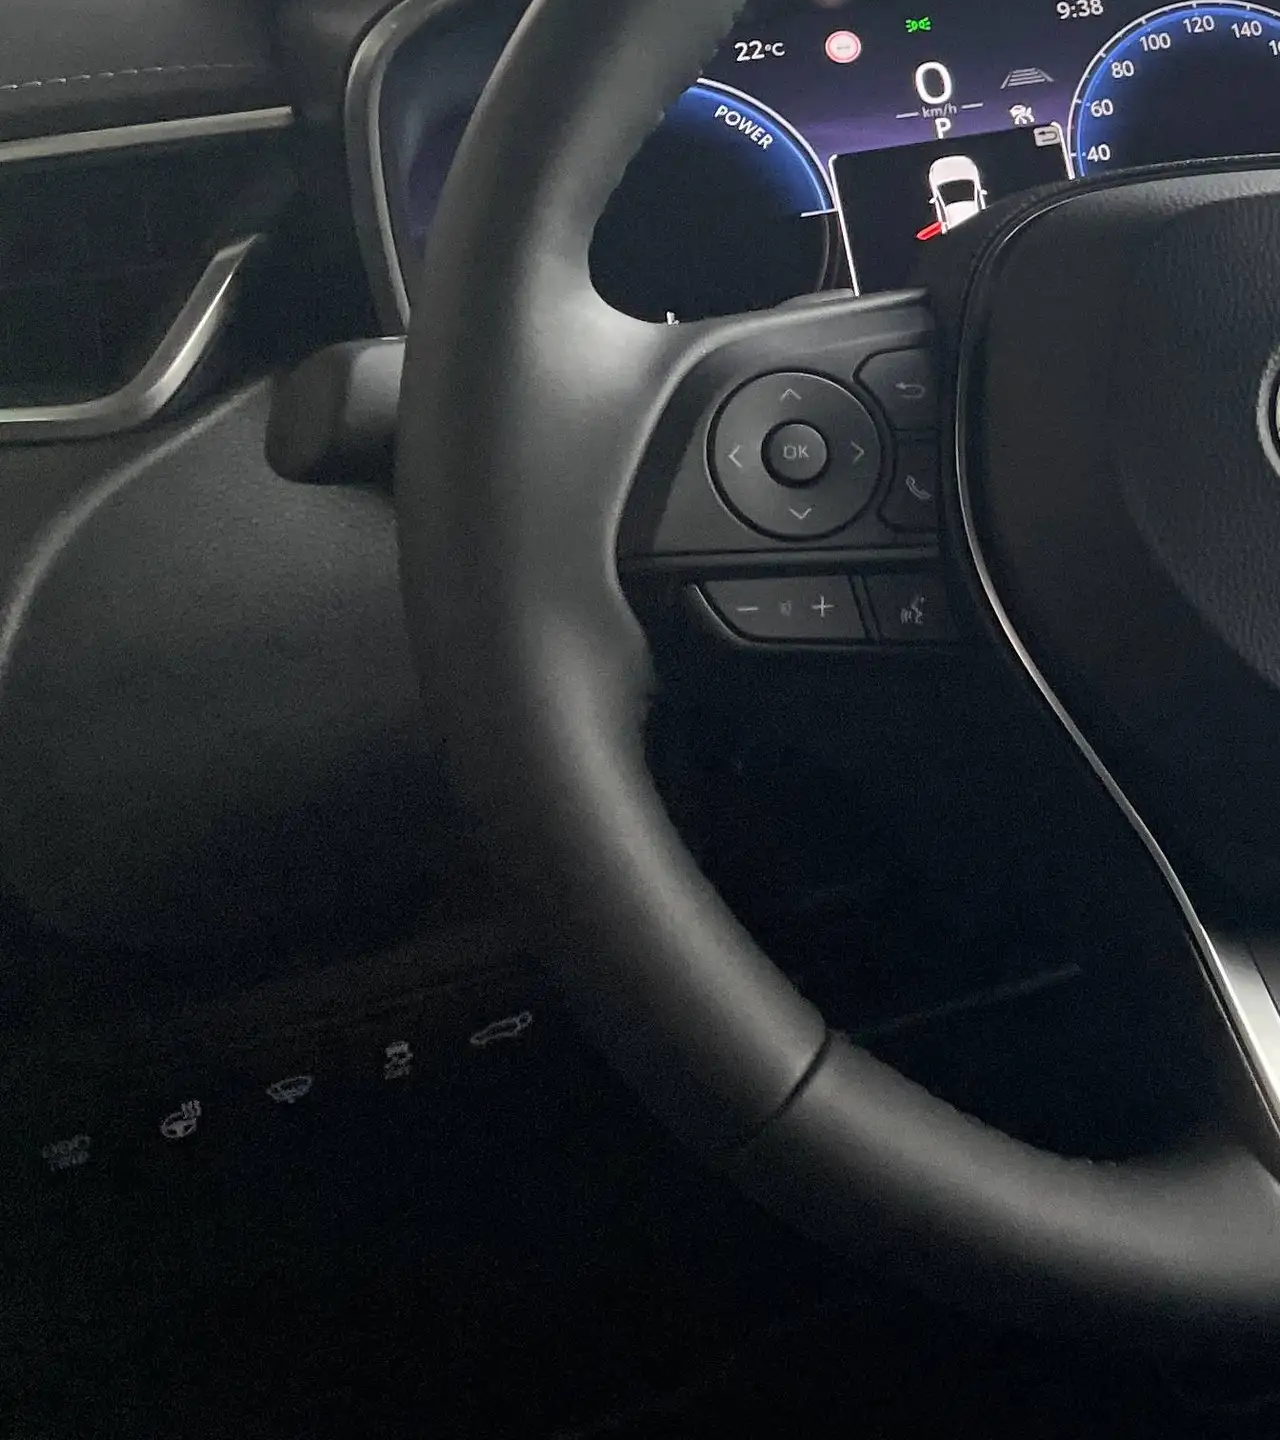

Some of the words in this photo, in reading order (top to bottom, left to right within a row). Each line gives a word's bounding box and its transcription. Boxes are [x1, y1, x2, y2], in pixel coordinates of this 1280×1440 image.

[1183, 15, 1215, 34] 120
[1231, 20, 1263, 39] 140
[1139, 32, 1171, 52] 100
[1111, 60, 1134, 79] 80
[914, 61, 953, 105] 0
[922, 102, 958, 118] km/h
[1091, 99, 1114, 117] 60
[714, 104, 773, 150] POWER
[934, 116, 952, 140] P
[1088, 143, 1111, 162] 40
[784, 445, 810, 459] OK
